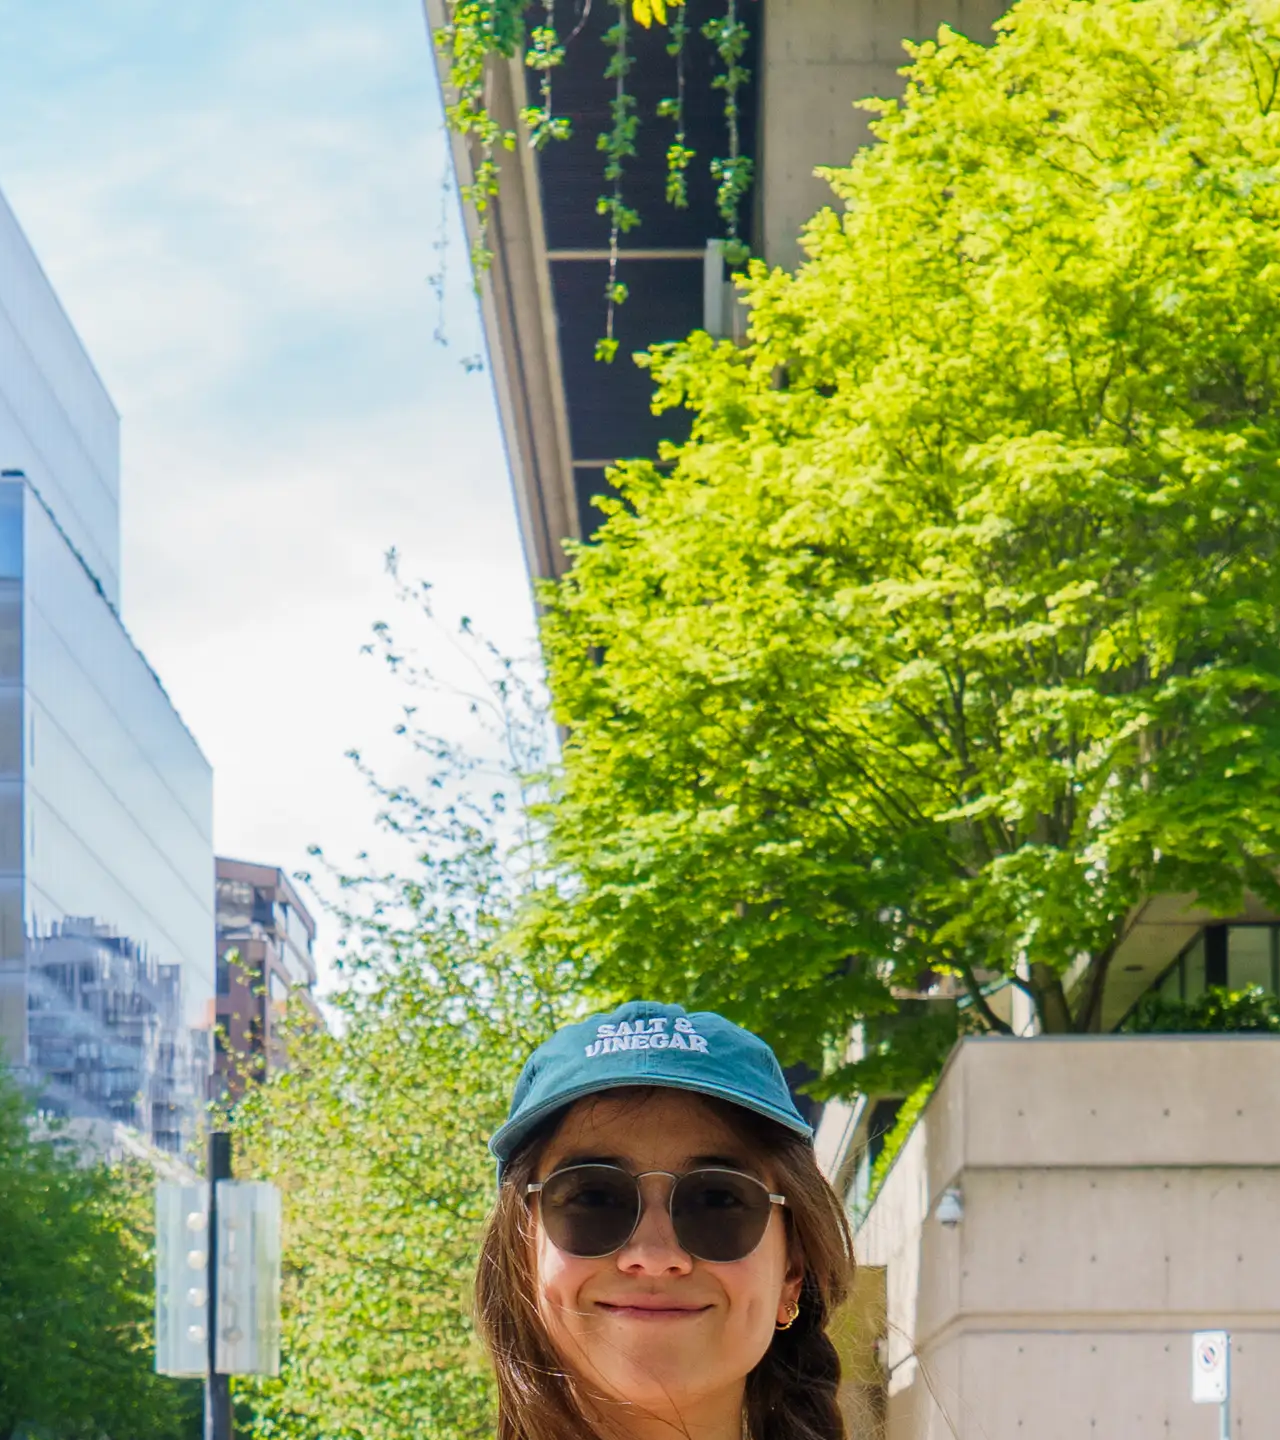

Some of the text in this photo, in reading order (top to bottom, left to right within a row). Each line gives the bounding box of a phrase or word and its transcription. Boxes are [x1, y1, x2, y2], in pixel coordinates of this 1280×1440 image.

[597, 1017, 696, 1038] SALT &
[585, 1033, 710, 1058] VINEGAR
